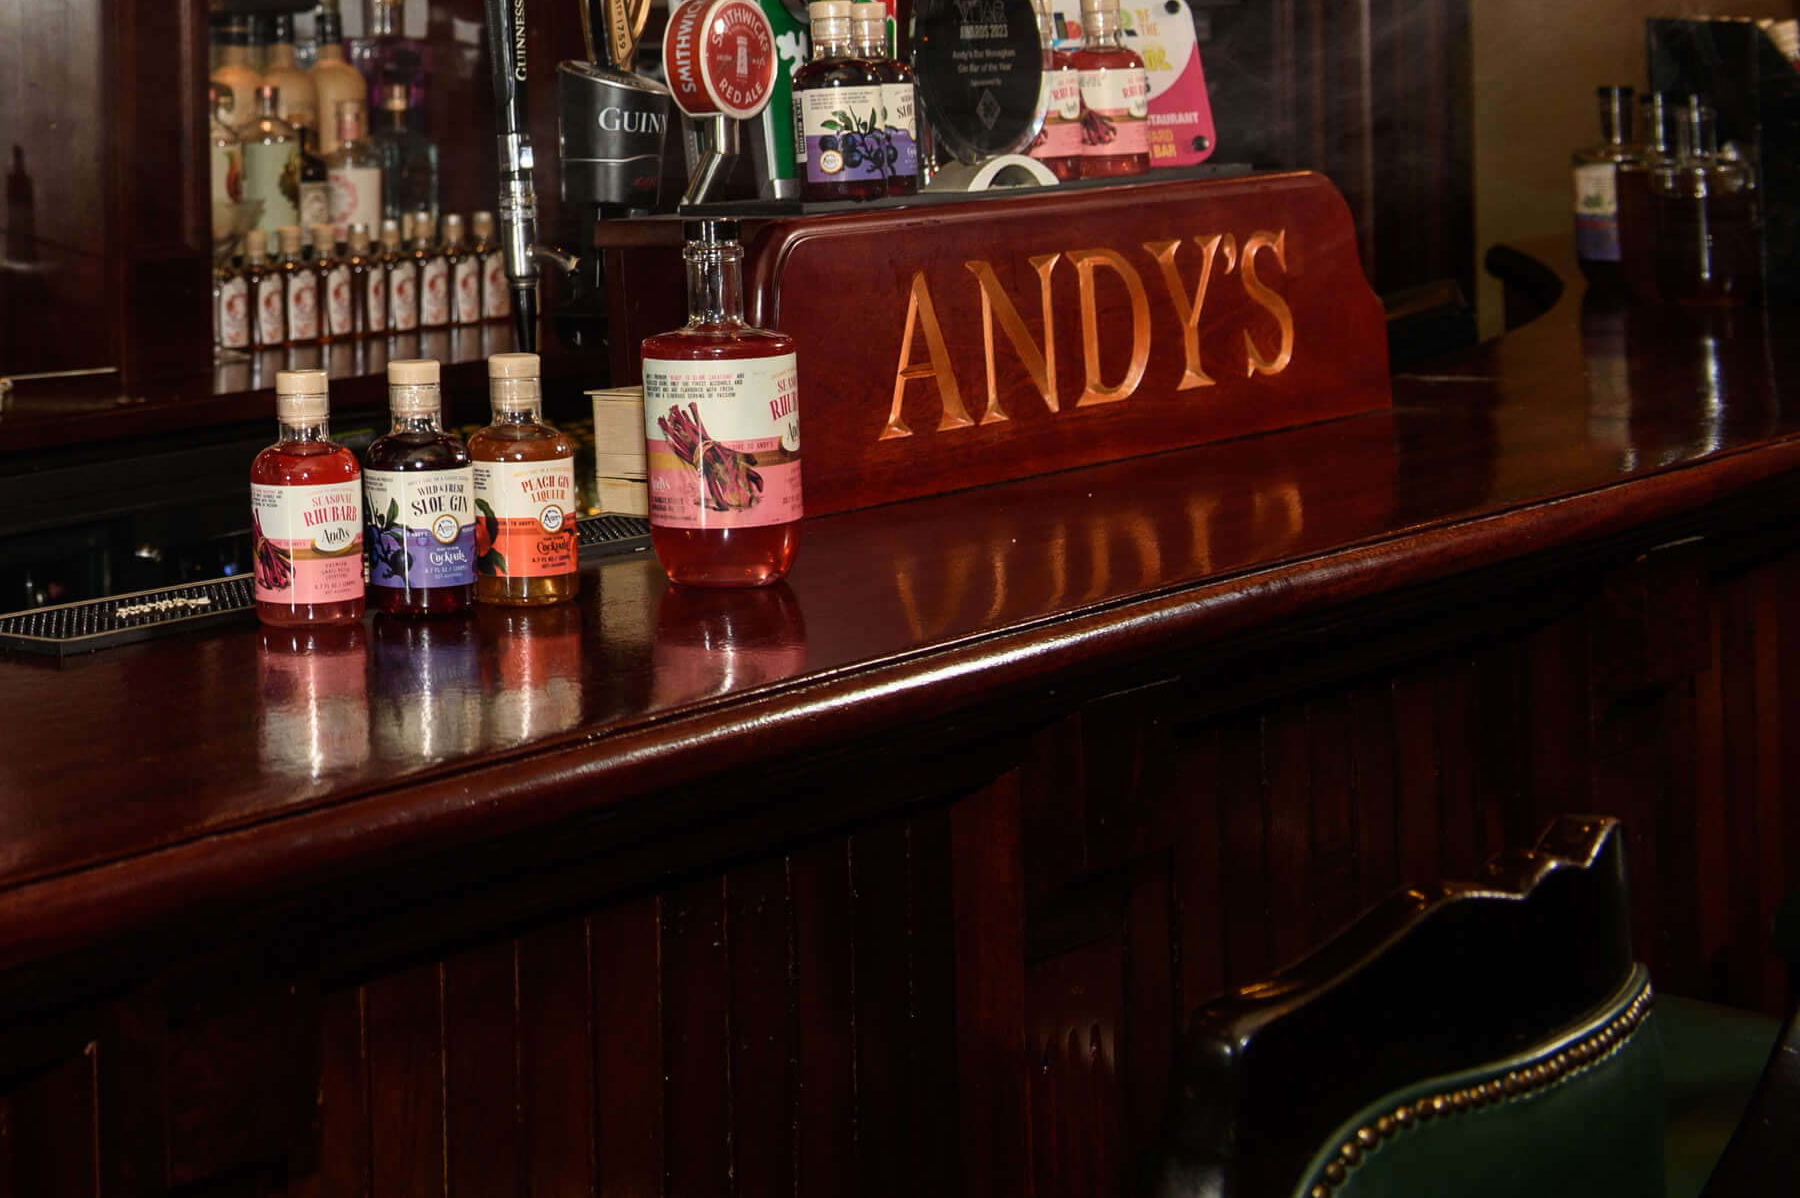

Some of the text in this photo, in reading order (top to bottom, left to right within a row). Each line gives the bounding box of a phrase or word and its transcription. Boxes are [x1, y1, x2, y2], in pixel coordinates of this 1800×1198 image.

[960, 24, 1009, 40] AWARDS 2023
[719, 77, 764, 105] RED ALE
[878, 228, 1295, 442] ANDY'S
[417, 486, 438, 496] WILD
[521, 474, 570, 493] PEACH GIN
[311, 493, 352, 507] SEASONAL
[411, 494, 468, 517] SLOE GIN
[303, 505, 358, 528] RHUBARB
[429, 549, 468, 567] Cocktails
